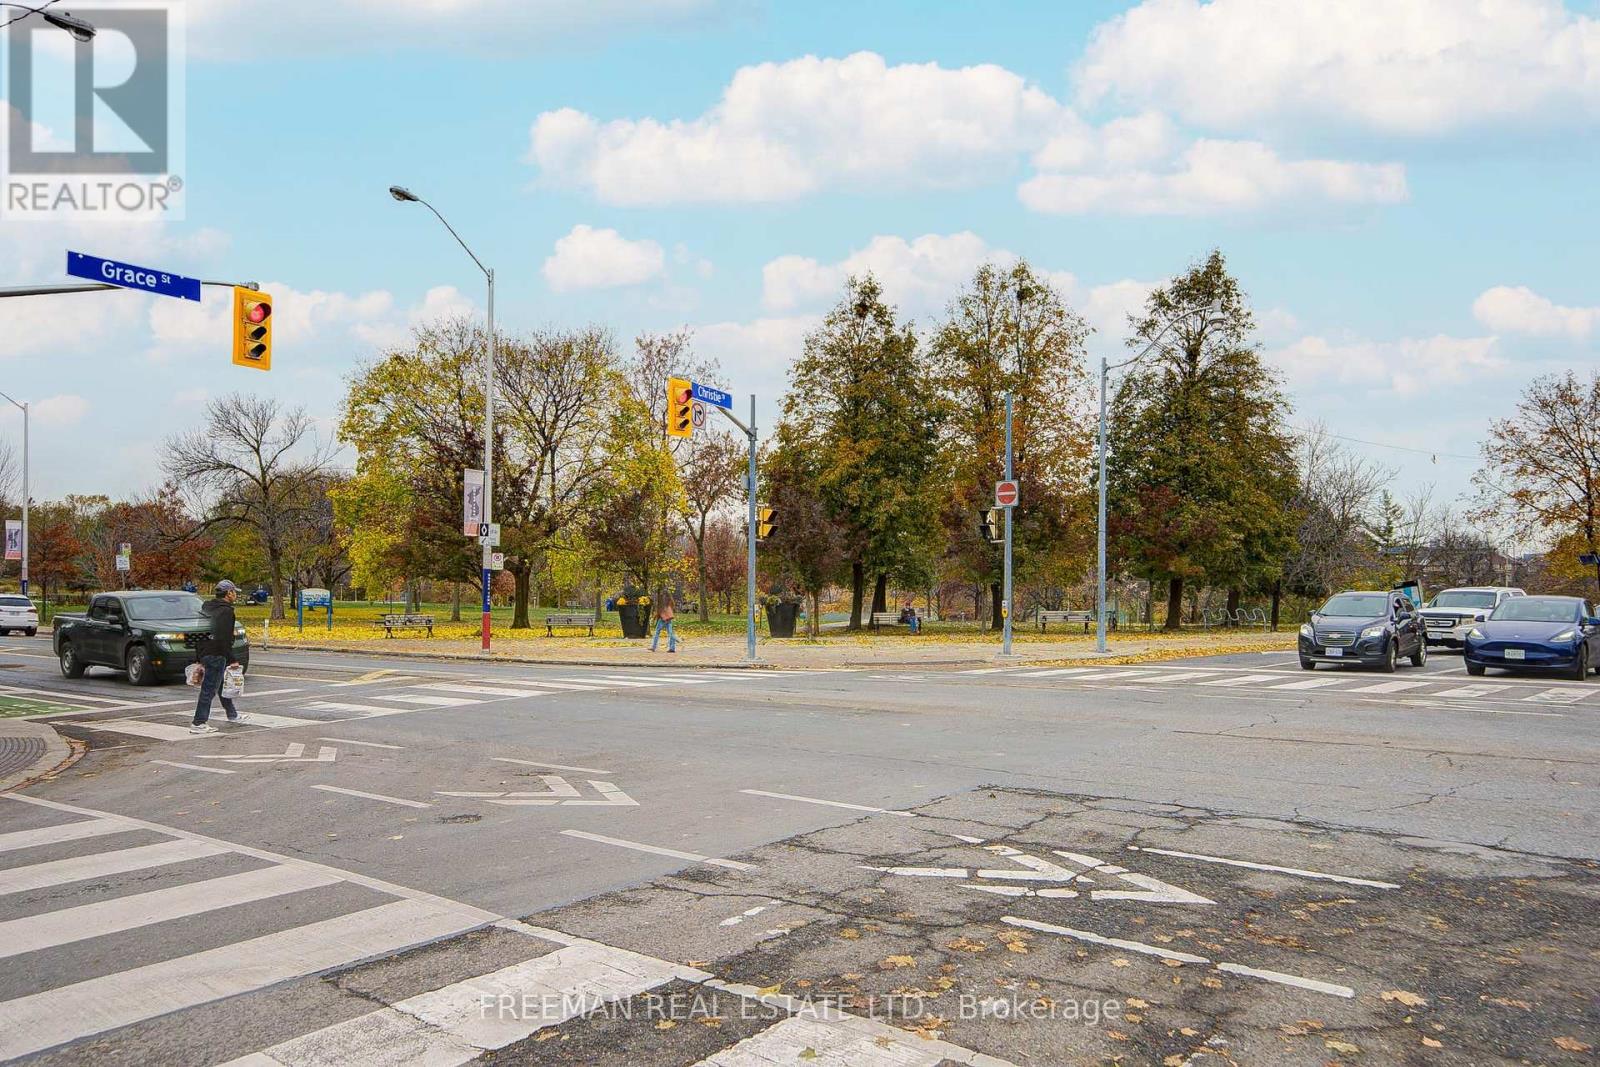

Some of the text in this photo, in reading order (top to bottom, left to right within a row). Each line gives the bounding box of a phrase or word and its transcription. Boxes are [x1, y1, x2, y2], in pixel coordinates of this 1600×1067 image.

[101, 261, 171, 288] Grace St
[697, 385, 722, 403] Christie
